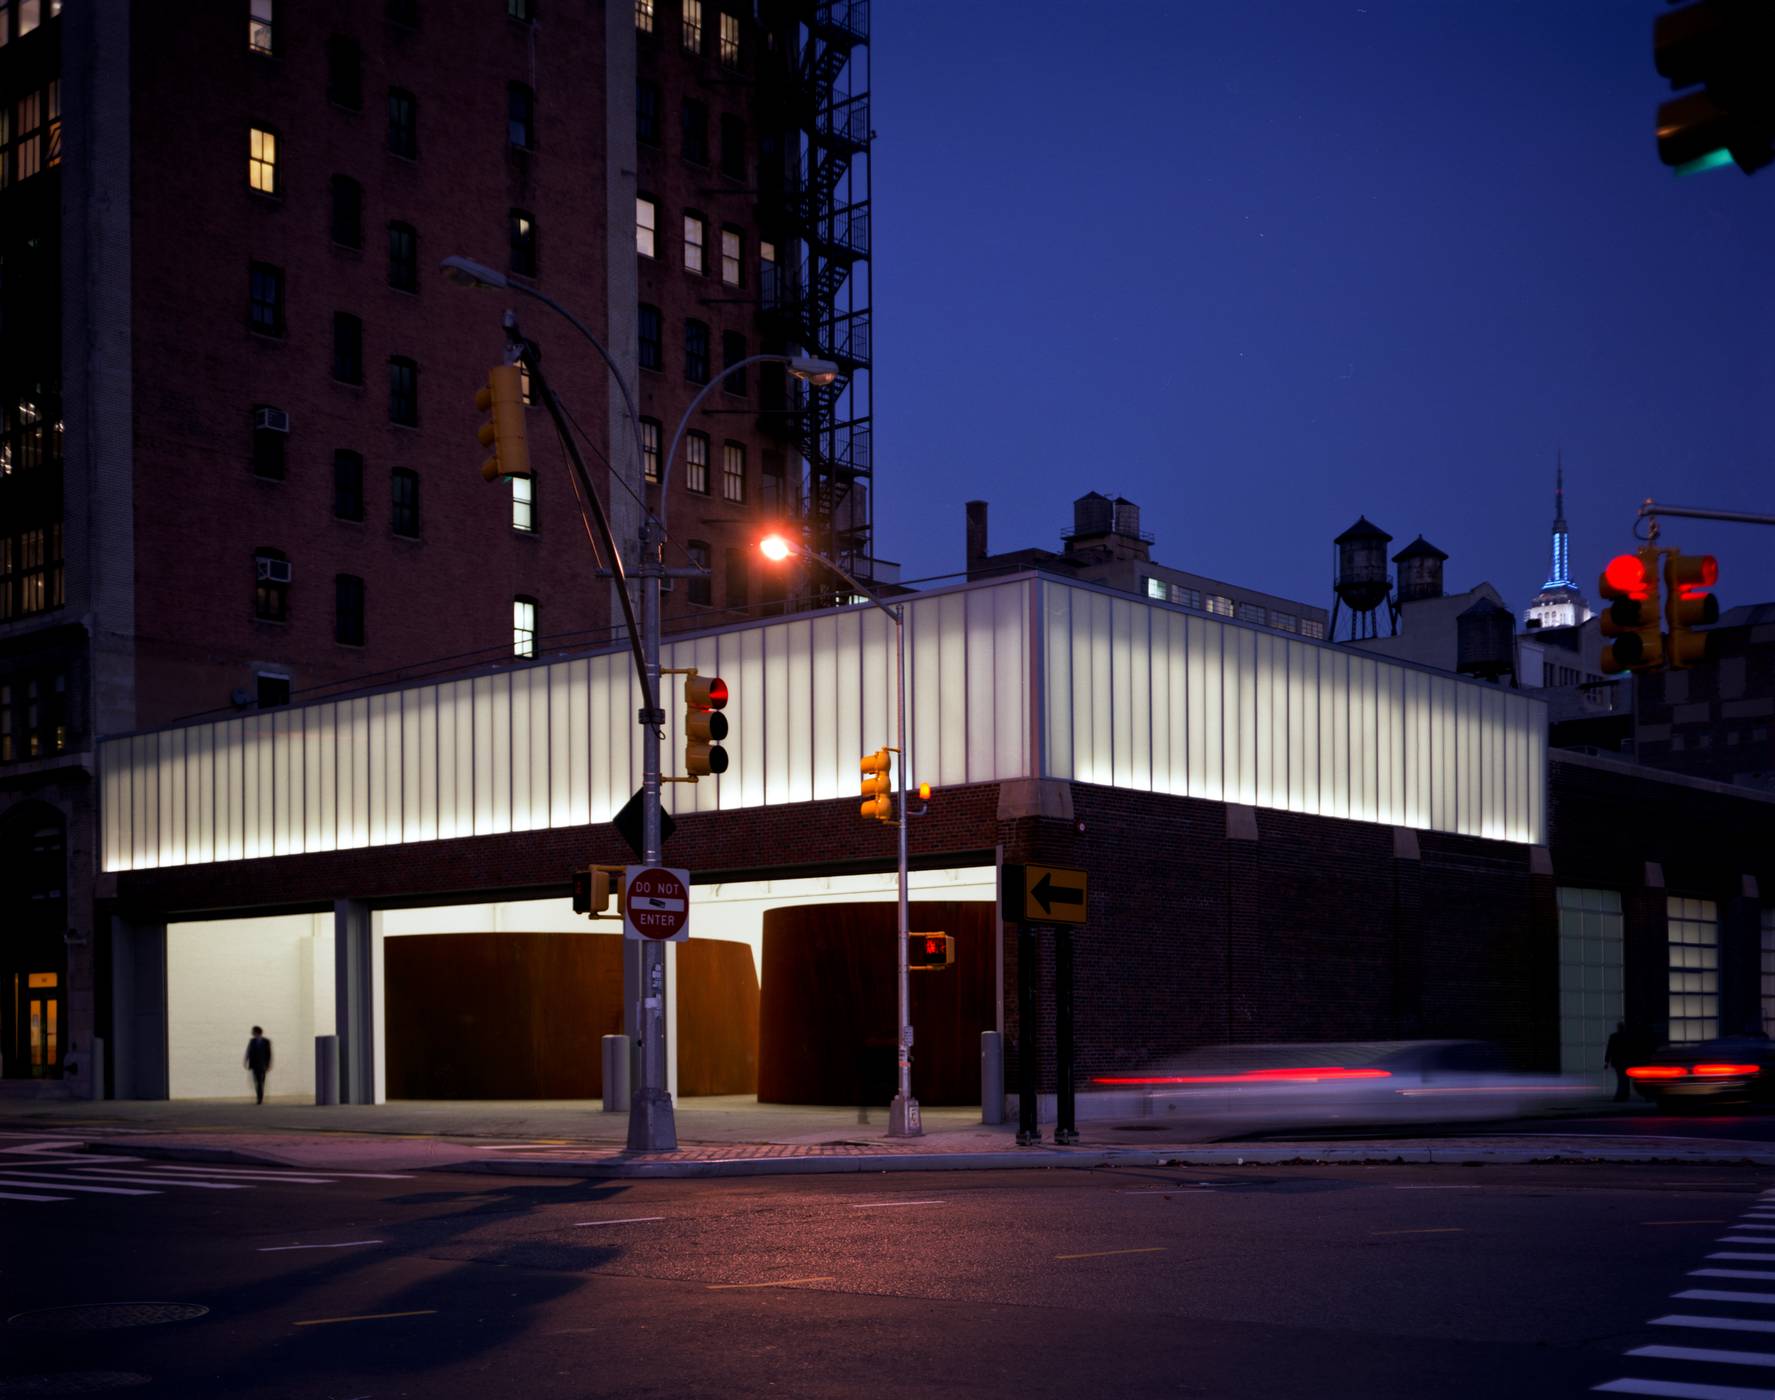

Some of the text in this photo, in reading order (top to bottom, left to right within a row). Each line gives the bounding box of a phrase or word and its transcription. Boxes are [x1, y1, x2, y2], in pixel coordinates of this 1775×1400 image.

[636, 881, 680, 895] DO NOT
[640, 913, 675, 926] ENTER
